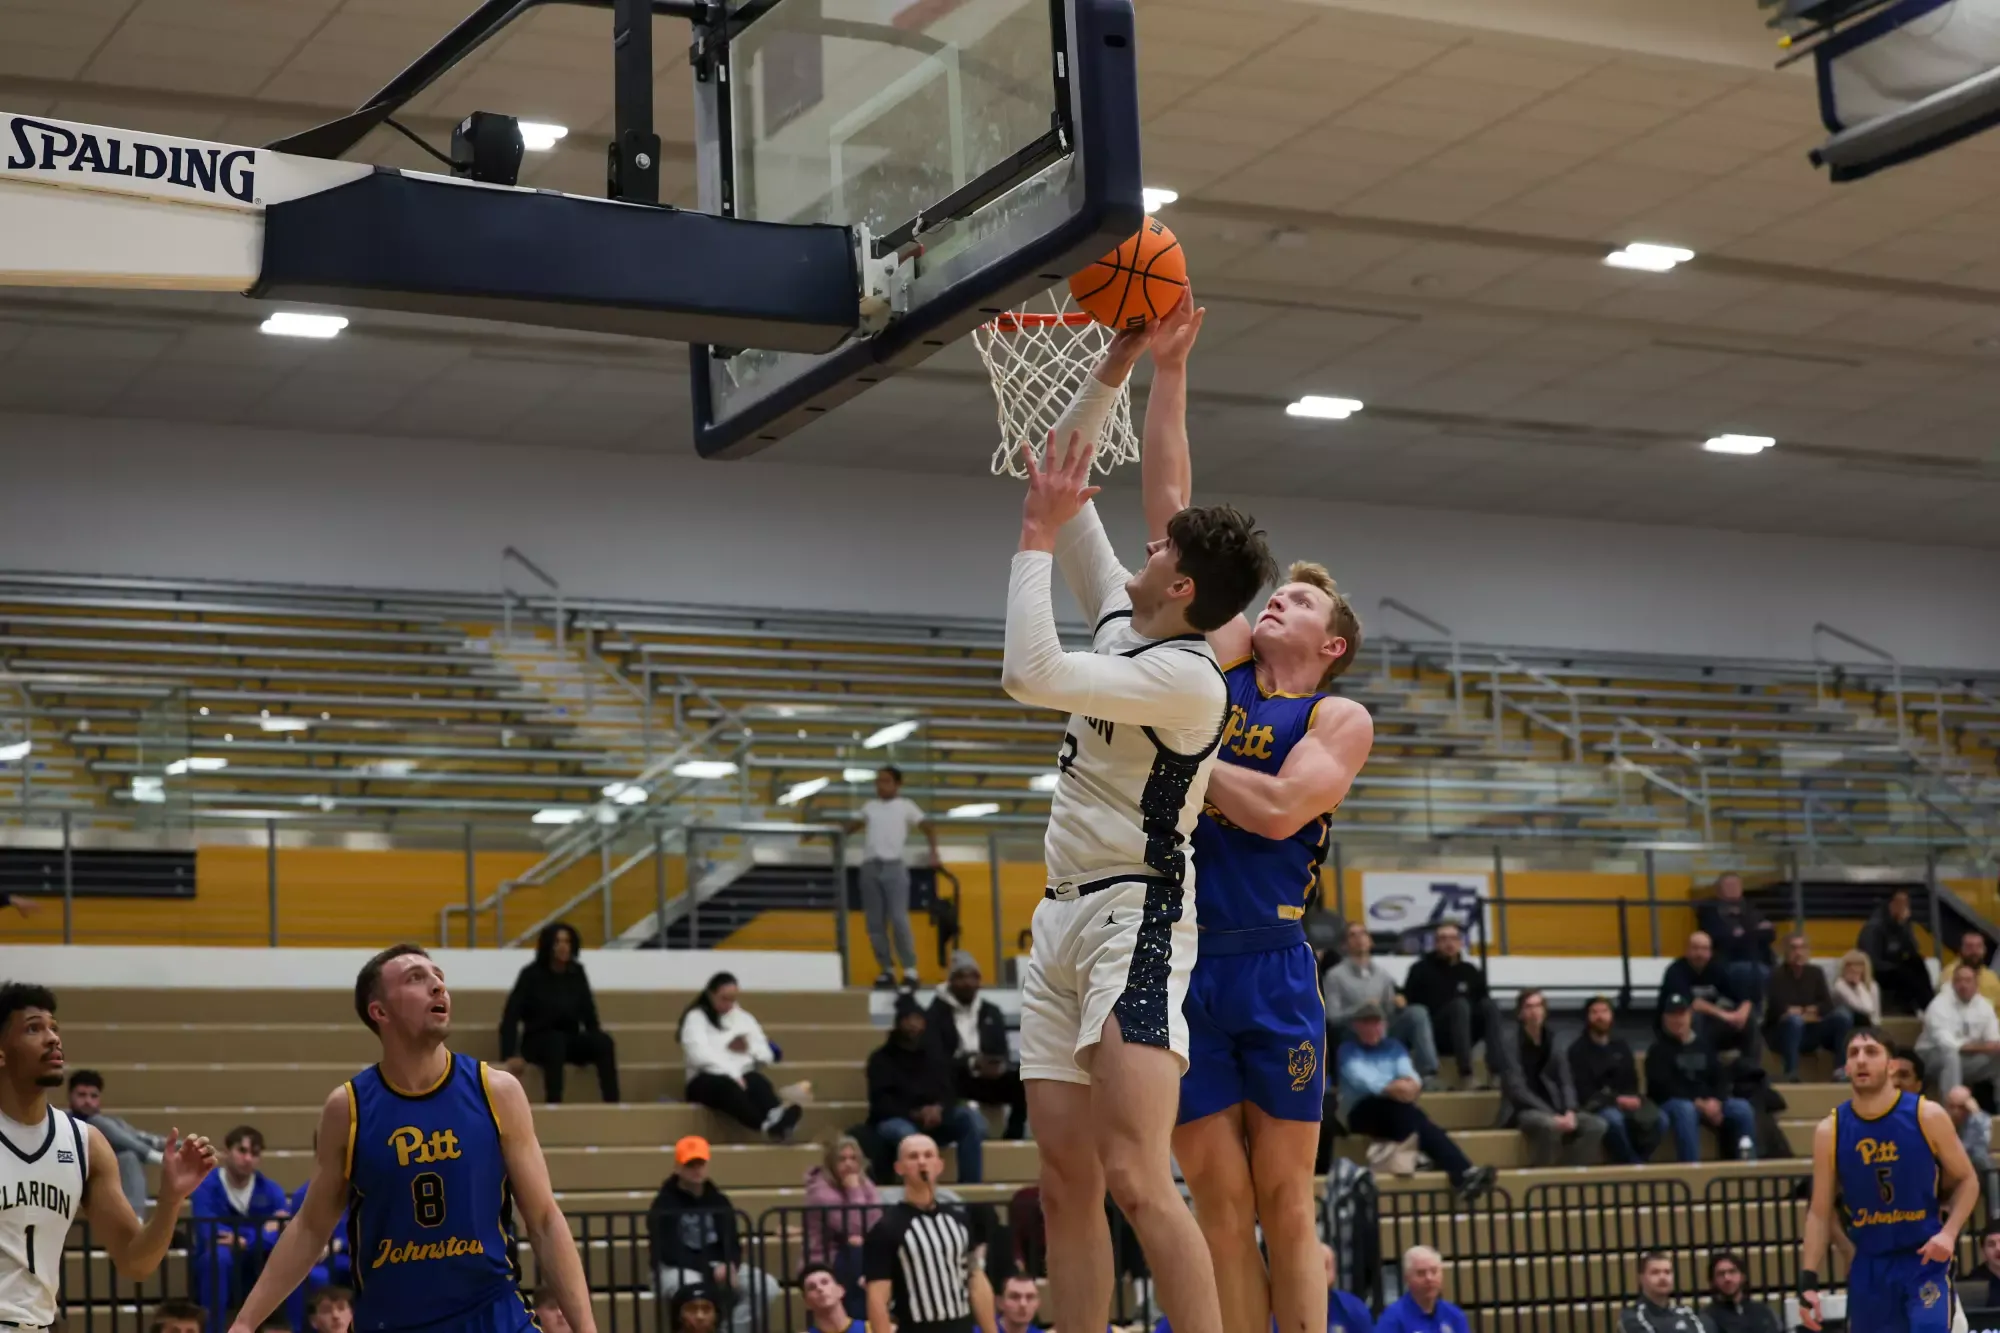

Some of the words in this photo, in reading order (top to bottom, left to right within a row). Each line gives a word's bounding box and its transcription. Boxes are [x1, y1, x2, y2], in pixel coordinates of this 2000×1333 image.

[8, 117, 255, 203] SPALDING
[387, 1126, 462, 1166] Pitt
[1855, 1137, 1900, 1165] Pitt
[0, 1180, 70, 1220] LARION
[411, 1171, 447, 1229] 8
[1877, 1166, 1895, 1205] 5
[25, 1224, 36, 1274] 1
